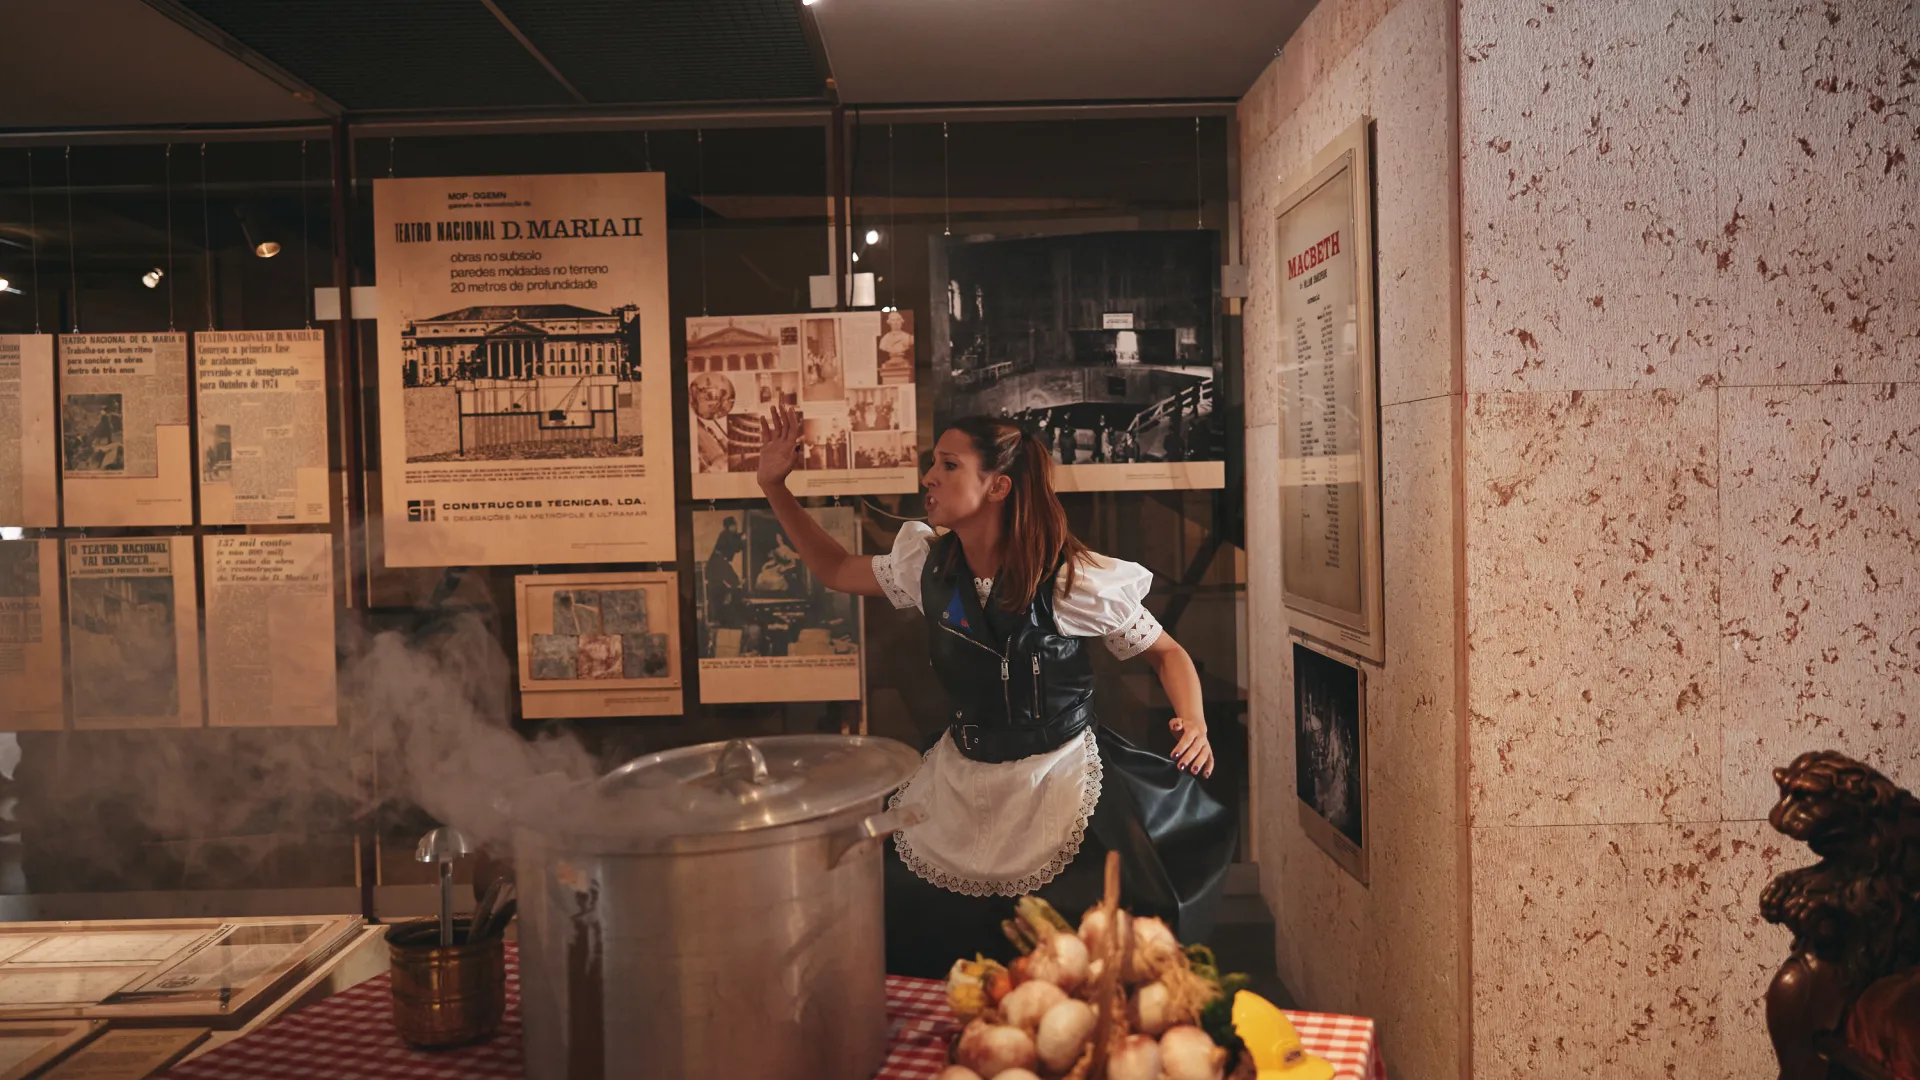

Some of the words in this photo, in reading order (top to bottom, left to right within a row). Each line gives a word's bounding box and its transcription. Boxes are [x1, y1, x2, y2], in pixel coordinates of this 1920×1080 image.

[395, 222, 432, 243] TEATRO
[437, 220, 495, 241] NACIONAL
[501, 221, 523, 240] D.
[526, 218, 619, 239] MARIA
[621, 217, 643, 236] II
[451, 252, 481, 262] obras
[484, 252, 497, 261] no
[500, 250, 541, 261] subsolo
[1287, 230, 1340, 280] MACBETH
[451, 267, 495, 279] paredes
[498, 264, 550, 276] moldadas
[553, 266, 567, 275] no
[569, 264, 608, 275] terreno
[451, 282, 465, 293] 20
[468, 281, 507, 292] metros
[510, 280, 524, 291] de
[527, 278, 597, 292] profundidade
[61, 336, 86, 346] TEATRO
[90, 336, 125, 344] NACIONAL
[152, 335, 176, 343] MARIA
[200, 333, 227, 342] TEATRO
[229, 332, 263, 341] NACIONAL
[286, 332, 311, 341] MARIA
[242, 344, 272, 356] primeira
[276, 344, 290, 353] fase
[85, 356, 111, 364] concluir
[103, 366, 116, 374] três
[255, 365, 299, 378] inauguração
[219, 380, 248, 389] Outubro
[251, 379, 258, 388] de
[597, 510, 647, 518] ULTRAMAR
[239, 538, 256, 546] mil
[260, 539, 292, 547] contos
[82, 545, 118, 554] TEATRO
[122, 543, 167, 553] NACIONAL
[82, 556, 98, 566] VAI
